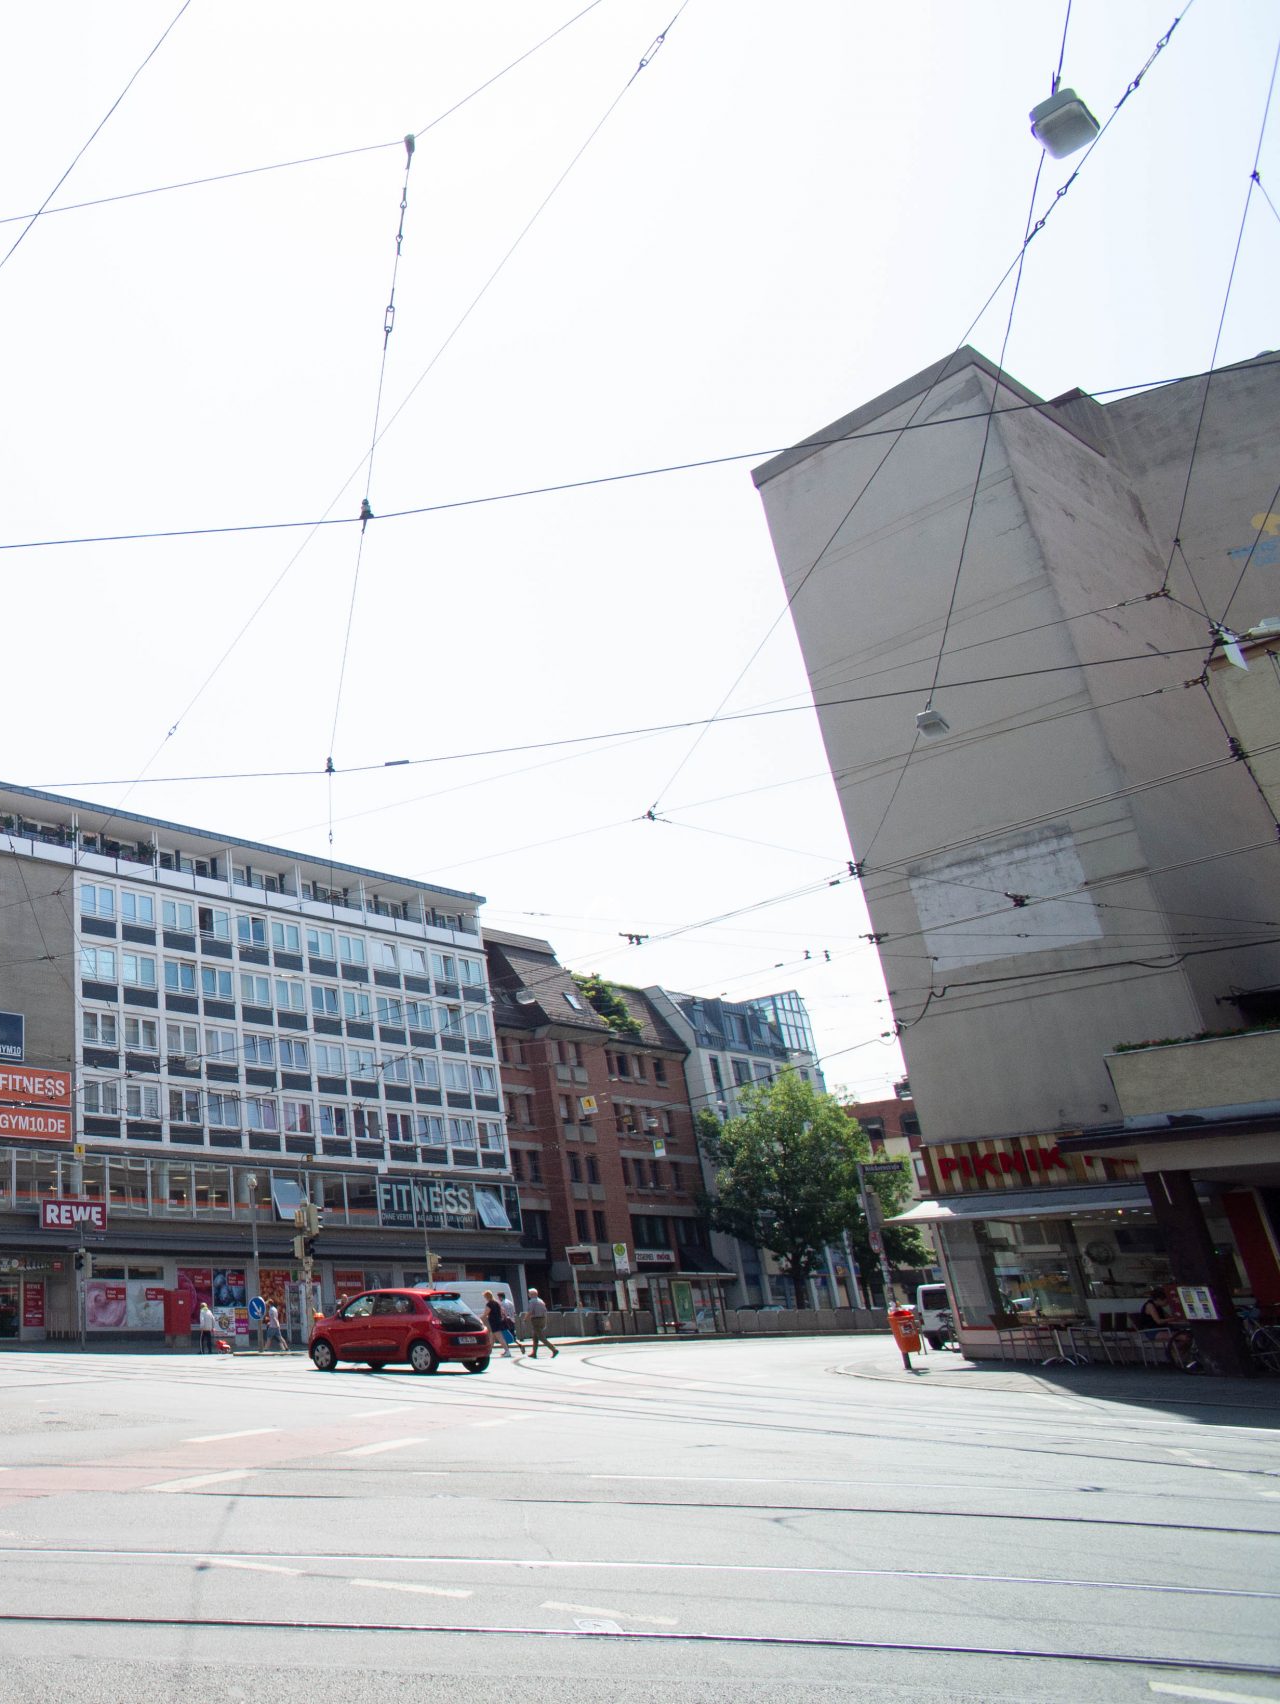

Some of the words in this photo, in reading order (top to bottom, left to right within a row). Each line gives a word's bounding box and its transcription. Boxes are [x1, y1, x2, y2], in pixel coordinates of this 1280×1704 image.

[938, 1147, 1068, 1180] PIKNIK
[380, 1183, 470, 1214] FITNESS
[46, 1206, 103, 1226] REWE
